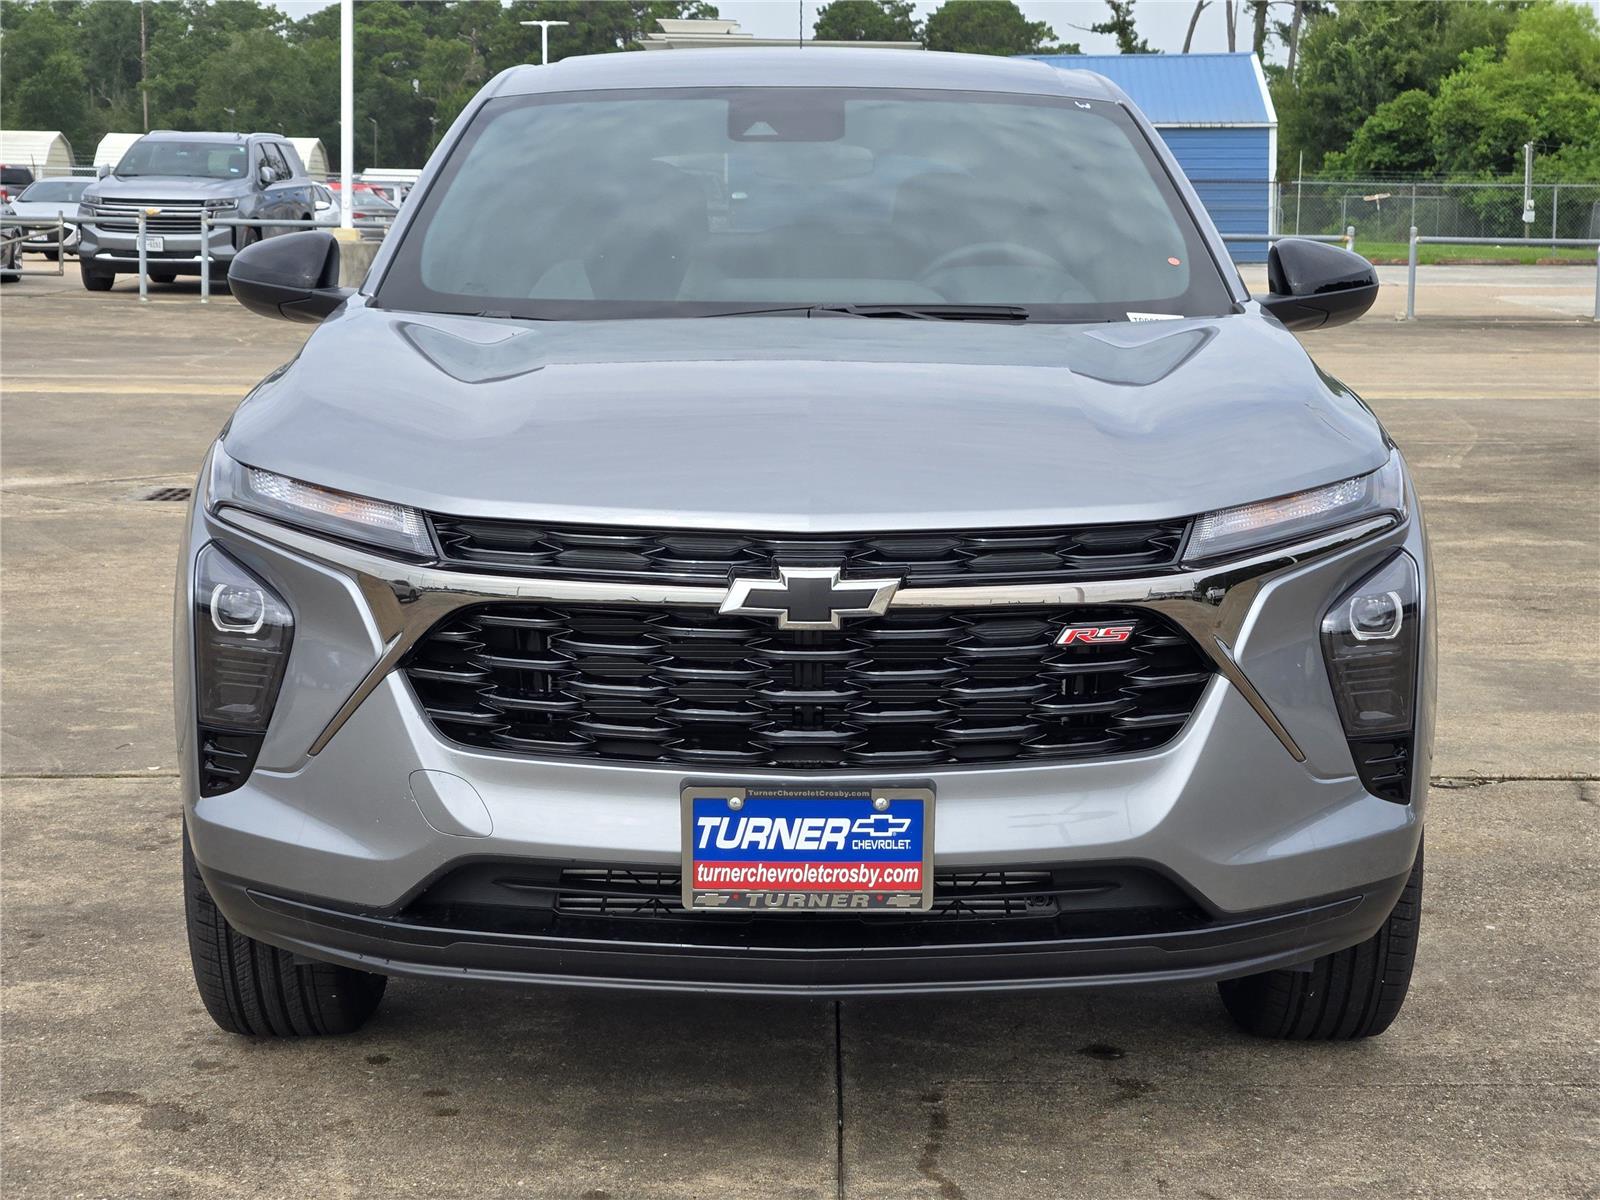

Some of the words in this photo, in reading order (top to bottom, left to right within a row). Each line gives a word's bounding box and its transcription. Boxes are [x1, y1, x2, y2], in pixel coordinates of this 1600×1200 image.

[1057, 626, 1132, 644] RS
[748, 789, 870, 798] TurnerChevroletCrosby.com
[697, 816, 851, 850] TURNER
[852, 839, 911, 850] CHEVROLET
[697, 863, 919, 887] turnerchevroletcrosby.com
[745, 893, 870, 908] TURNER
